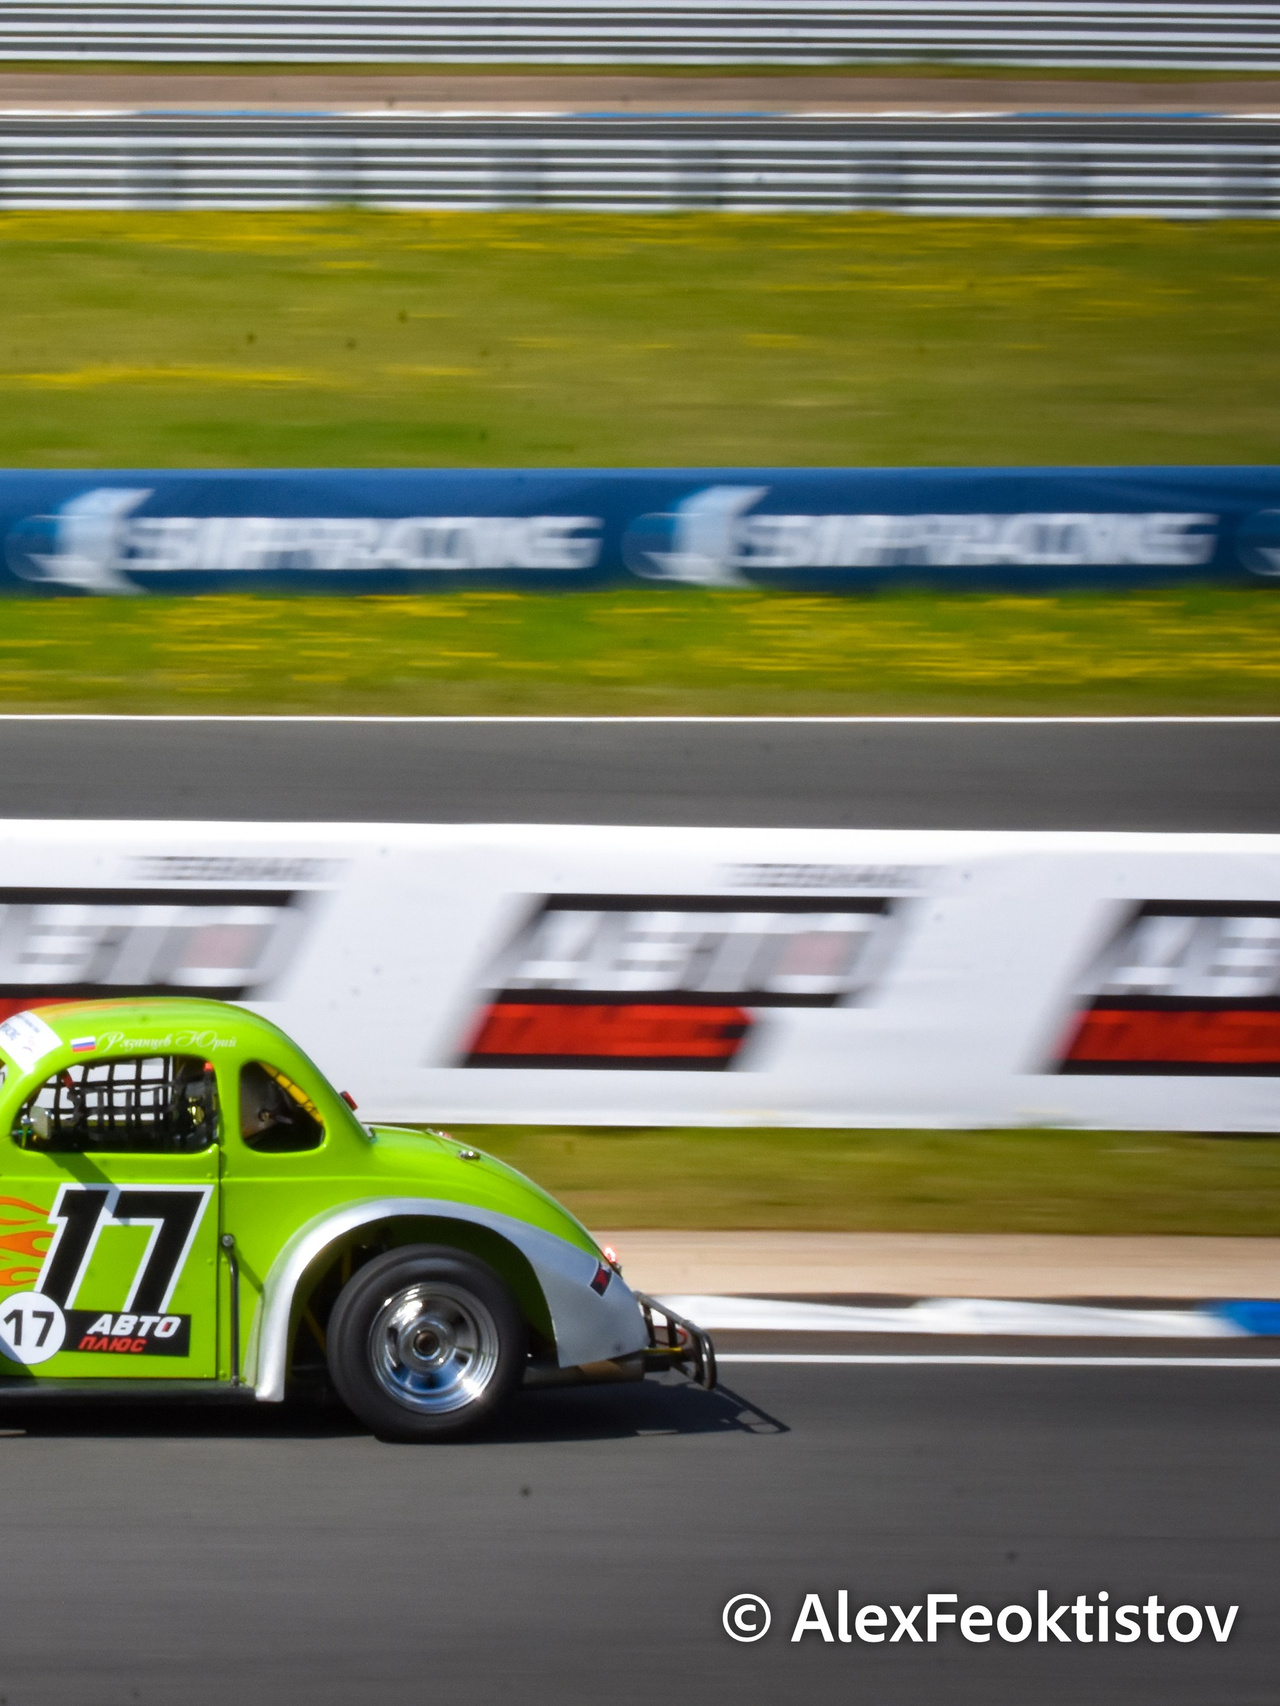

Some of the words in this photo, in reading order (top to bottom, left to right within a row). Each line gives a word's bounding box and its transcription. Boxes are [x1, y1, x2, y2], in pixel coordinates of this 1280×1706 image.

[175, 1030, 237, 1052] Юрий
[38, 1184, 213, 1314] 17
[3, 1309, 55, 1348] 17
[86, 1313, 182, 1338] АВТО
[78, 1335, 148, 1353] ПЛЮС
